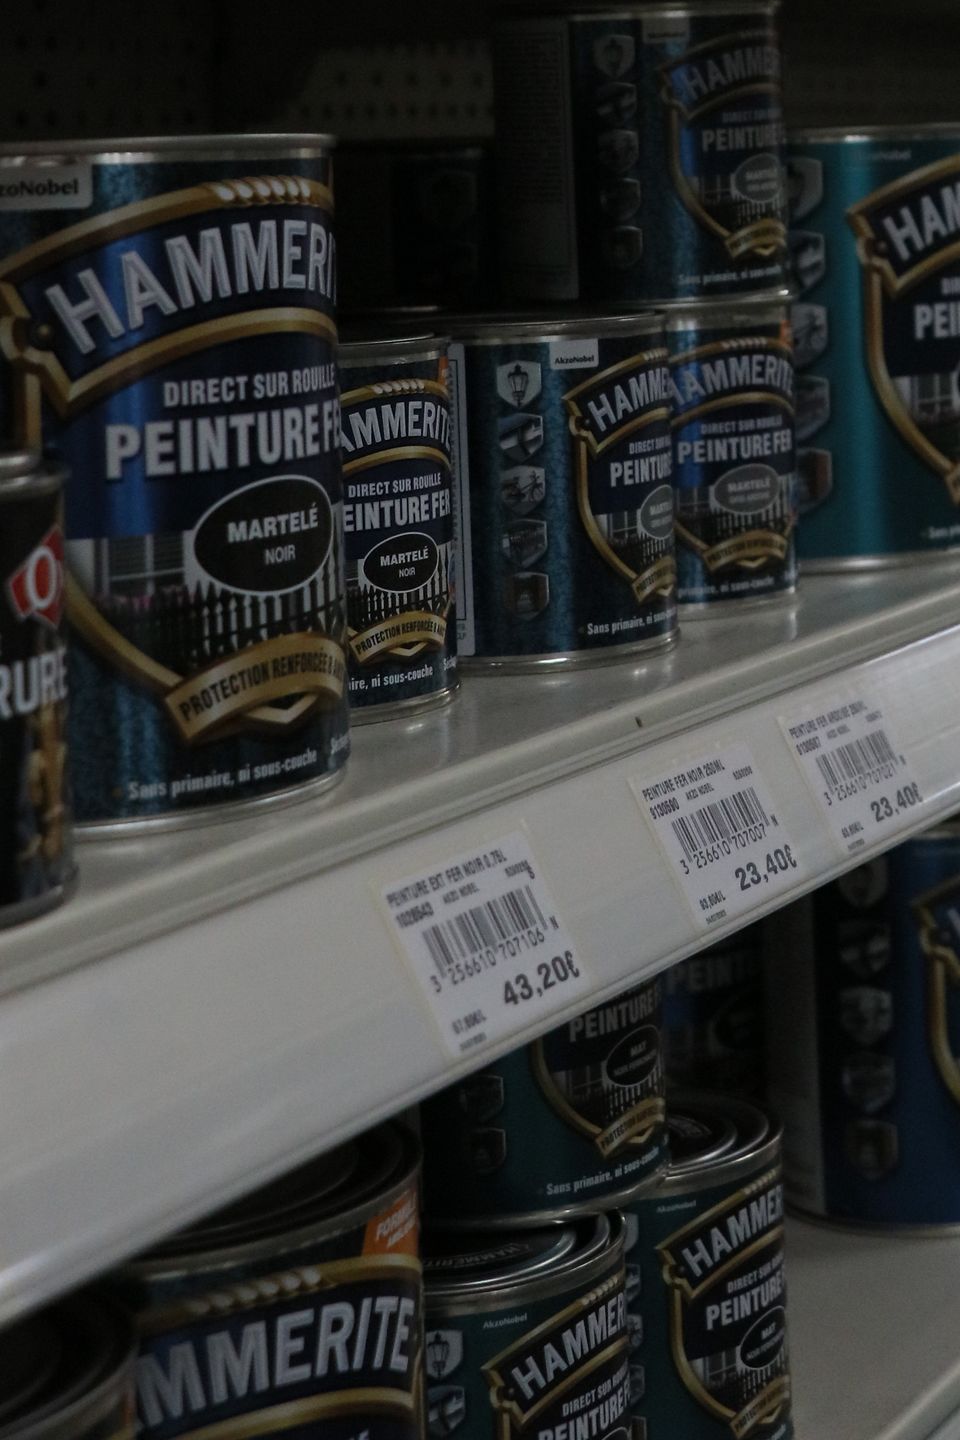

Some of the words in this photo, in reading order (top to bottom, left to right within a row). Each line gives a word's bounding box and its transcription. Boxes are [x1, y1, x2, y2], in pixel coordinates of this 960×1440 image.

[44, 218, 338, 356] HAMMERI
[163, 375, 248, 409] DIRECT
[252, 371, 289, 400] SUR
[292, 361, 336, 394] ROUILLE
[104, 406, 317, 481] PEINTURE
[701, 420, 737, 435] DIRECT
[677, 431, 772, 464] PEINTURE
[348, 480, 391, 499] DIRECT
[392, 478, 411, 494] SUR
[413, 472, 441, 491] ROUILLE
[431, 487, 451, 520] FER
[227, 501, 320, 544] MARTELÉ
[264, 544, 296, 566] NOIR
[380, 545, 430, 567] MARTELÉ
[398, 566, 416, 579] NOIR
[354, 623, 400, 655] PROTECTION
[587, 622, 610, 636] Sans
[178, 661, 270, 723] PROTECTION
[371, 673, 381, 688] ni
[383, 663, 434, 687] sous-couche
[128, 780, 167, 801] Sans
[171, 766, 235, 799] primaire,
[238, 762, 250, 783] ni
[253, 747, 318, 780] sous-couche
[641, 778, 676, 802] PEINTURE
[675, 773, 688, 790] FER
[688, 766, 703, 782] NOIR
[823, 791, 833, 806] 3
[870, 781, 924, 823] 23,40€
[680, 859, 690, 875] 3
[692, 839, 732, 869] 256610
[731, 822, 767, 850] 707007
[386, 879, 429, 907] PEINTURE
[429, 873, 445, 892] EXT
[445, 865, 465, 884] FER
[465, 856, 486, 878] NOIR
[734, 843, 798, 892] 23,40€
[430, 975, 442, 993] 3
[447, 949, 498, 986] 256610
[498, 927, 545, 961] 707106
[503, 950, 581, 1006] 43,20€
[546, 1181, 572, 1196] Sans
[561, 1388, 597, 1418] DIRECT
